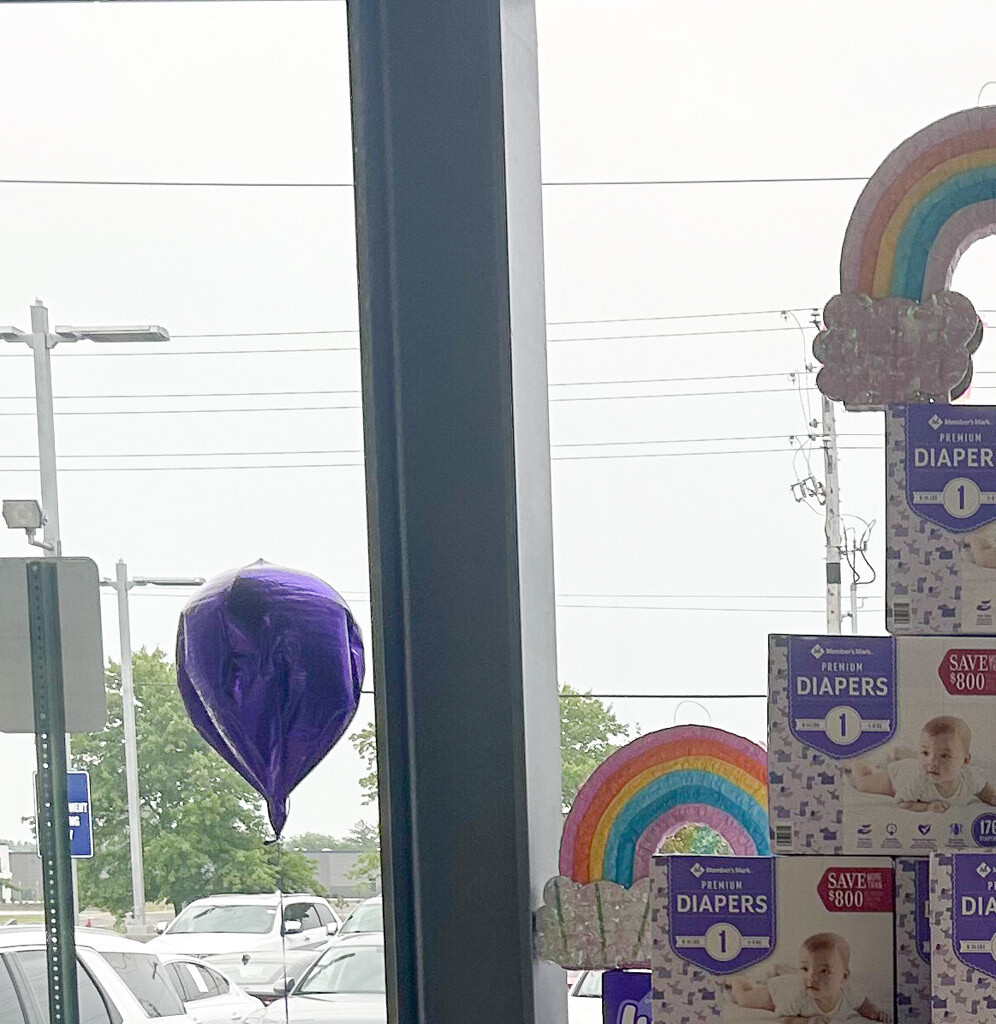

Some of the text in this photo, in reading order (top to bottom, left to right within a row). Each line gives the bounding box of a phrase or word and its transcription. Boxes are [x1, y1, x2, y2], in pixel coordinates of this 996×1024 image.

[939, 432, 982, 443] PREMIUM
[957, 485, 965, 510] 1
[949, 653, 988, 672] SAVE
[797, 676, 888, 696] DIAPERS
[949, 672, 985, 691] $800
[827, 871, 866, 889] SAVE
[677, 894, 768, 914] DIAPERS
[828, 889, 864, 908] $800
